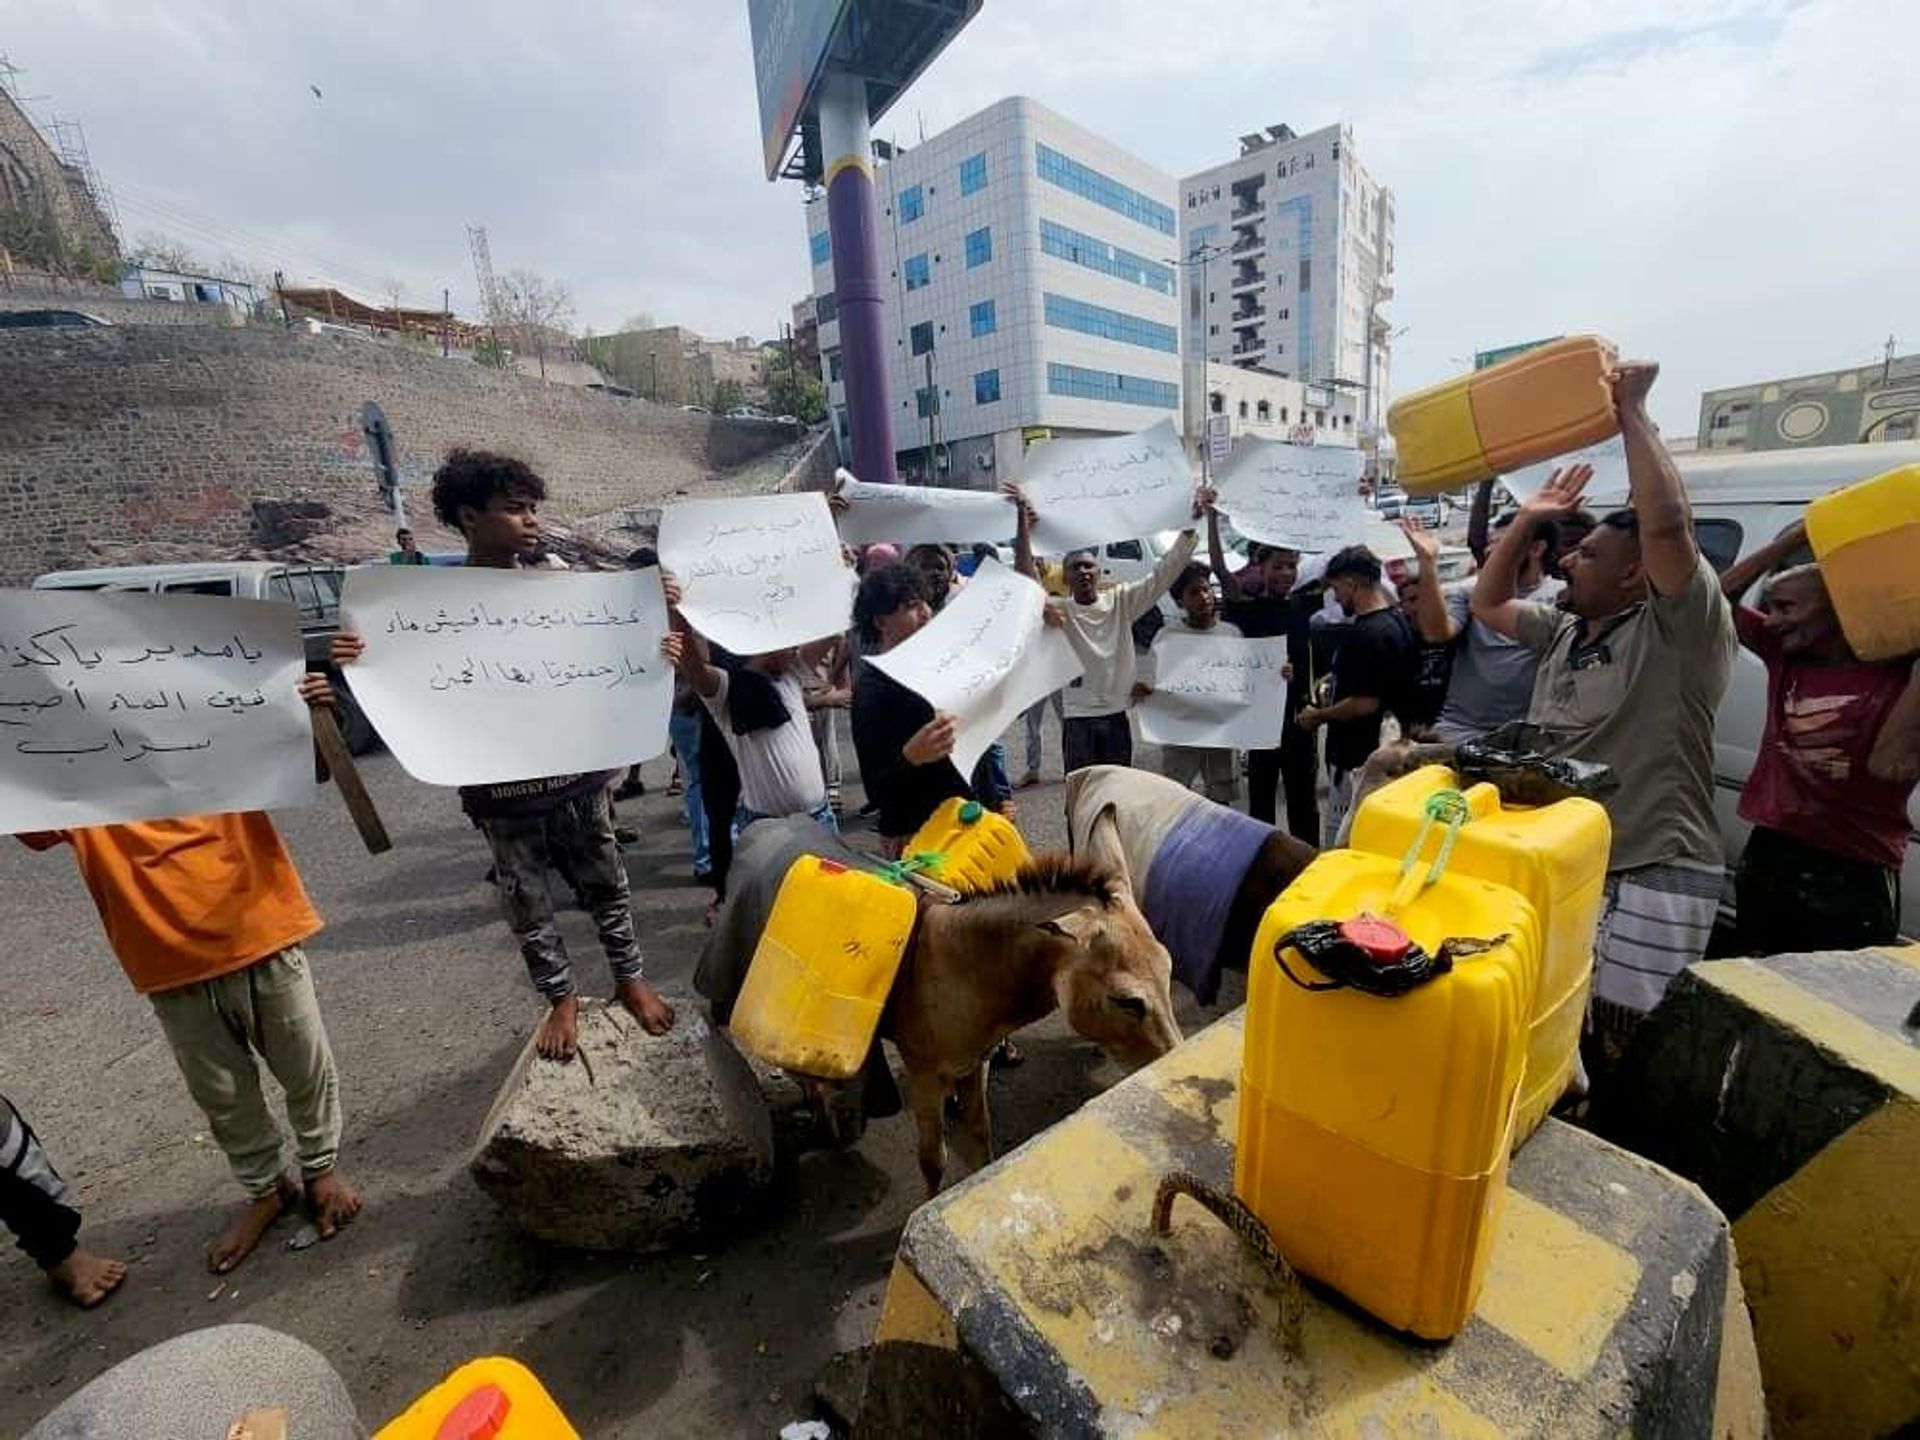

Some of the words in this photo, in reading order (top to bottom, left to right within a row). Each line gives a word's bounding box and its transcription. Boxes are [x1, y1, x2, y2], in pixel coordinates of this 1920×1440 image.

[108, 690, 187, 711] الماء
[207, 688, 265, 714] فين
[16, 728, 212, 763] سراب
